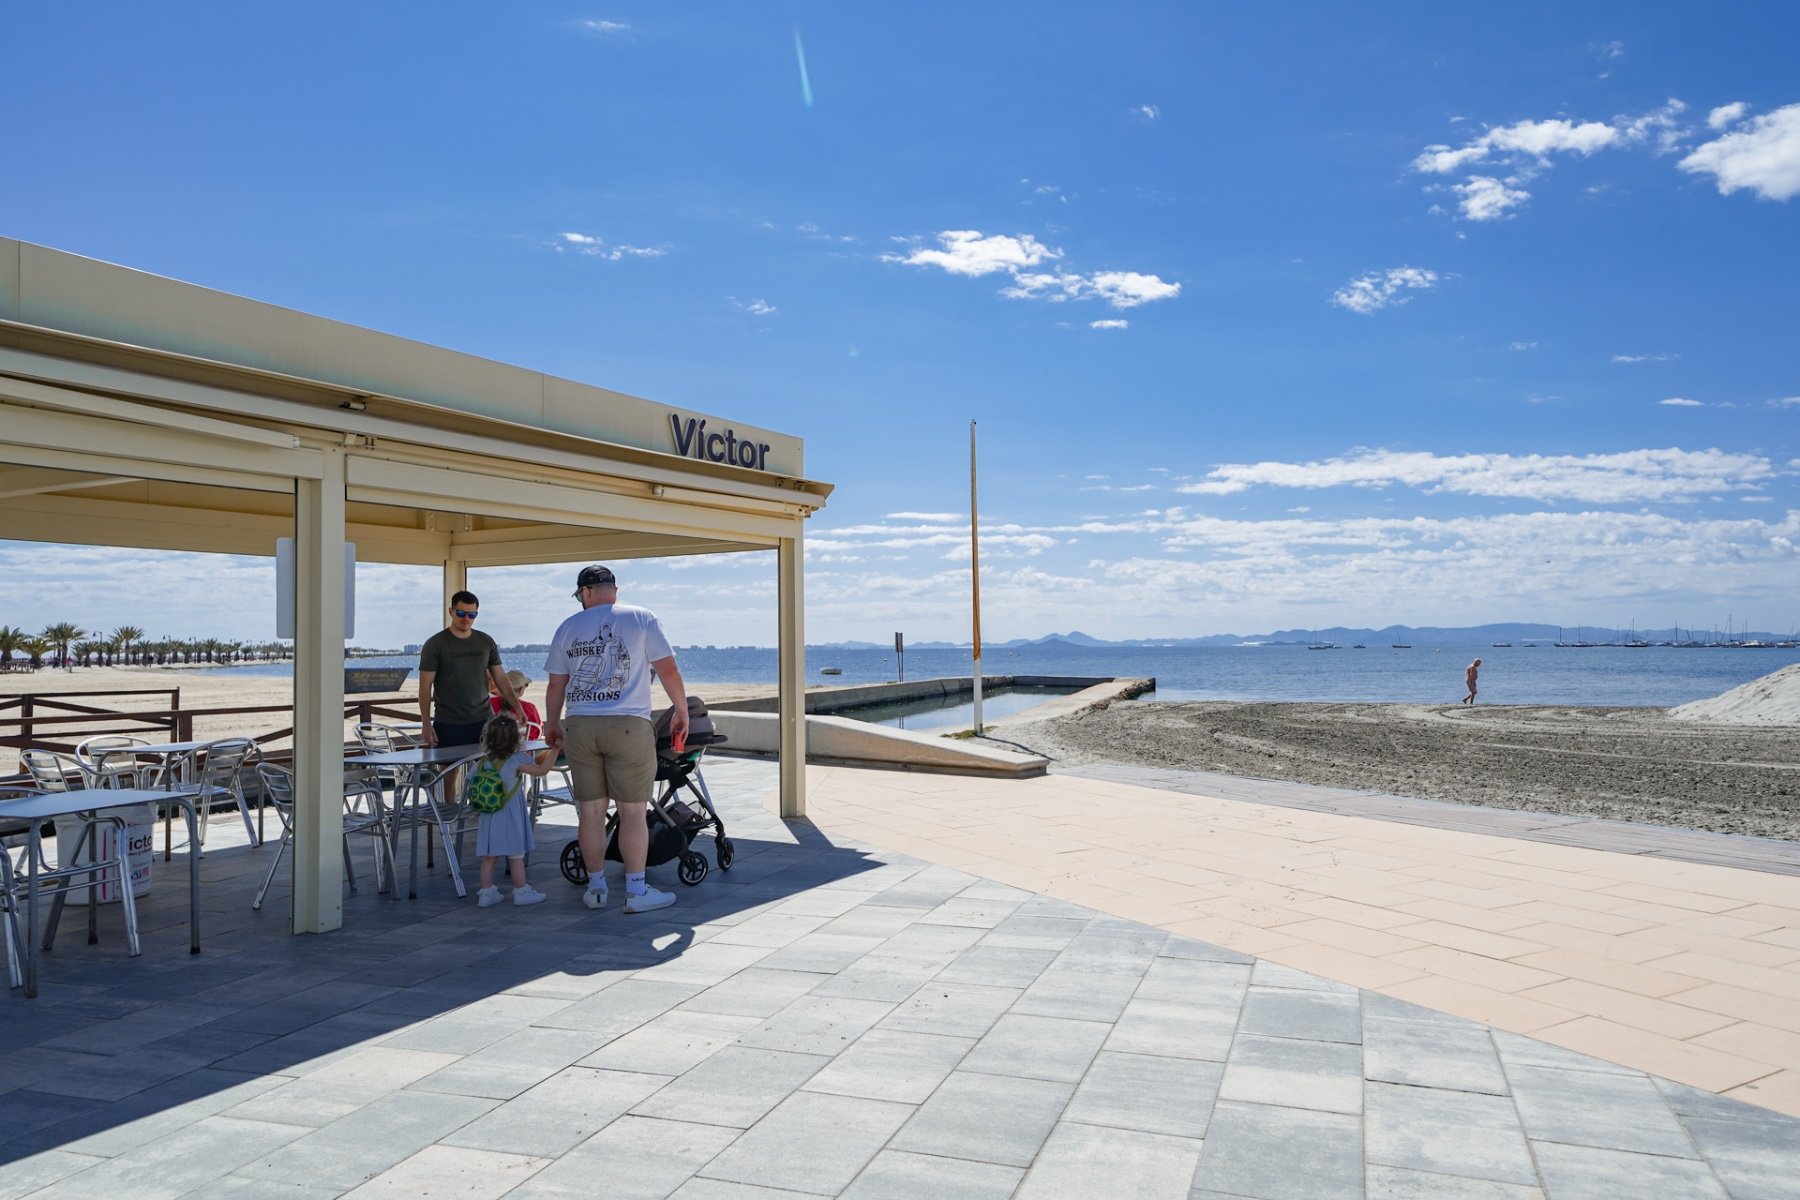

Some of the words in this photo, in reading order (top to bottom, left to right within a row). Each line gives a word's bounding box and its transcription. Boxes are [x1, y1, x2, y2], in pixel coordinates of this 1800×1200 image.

[670, 413, 770, 470] Víctor
[572, 637, 597, 648] Good
[566, 644, 606, 659] WHISKEY
[566, 690, 621, 702] DECISIONS
[129, 834, 152, 851] ícto
